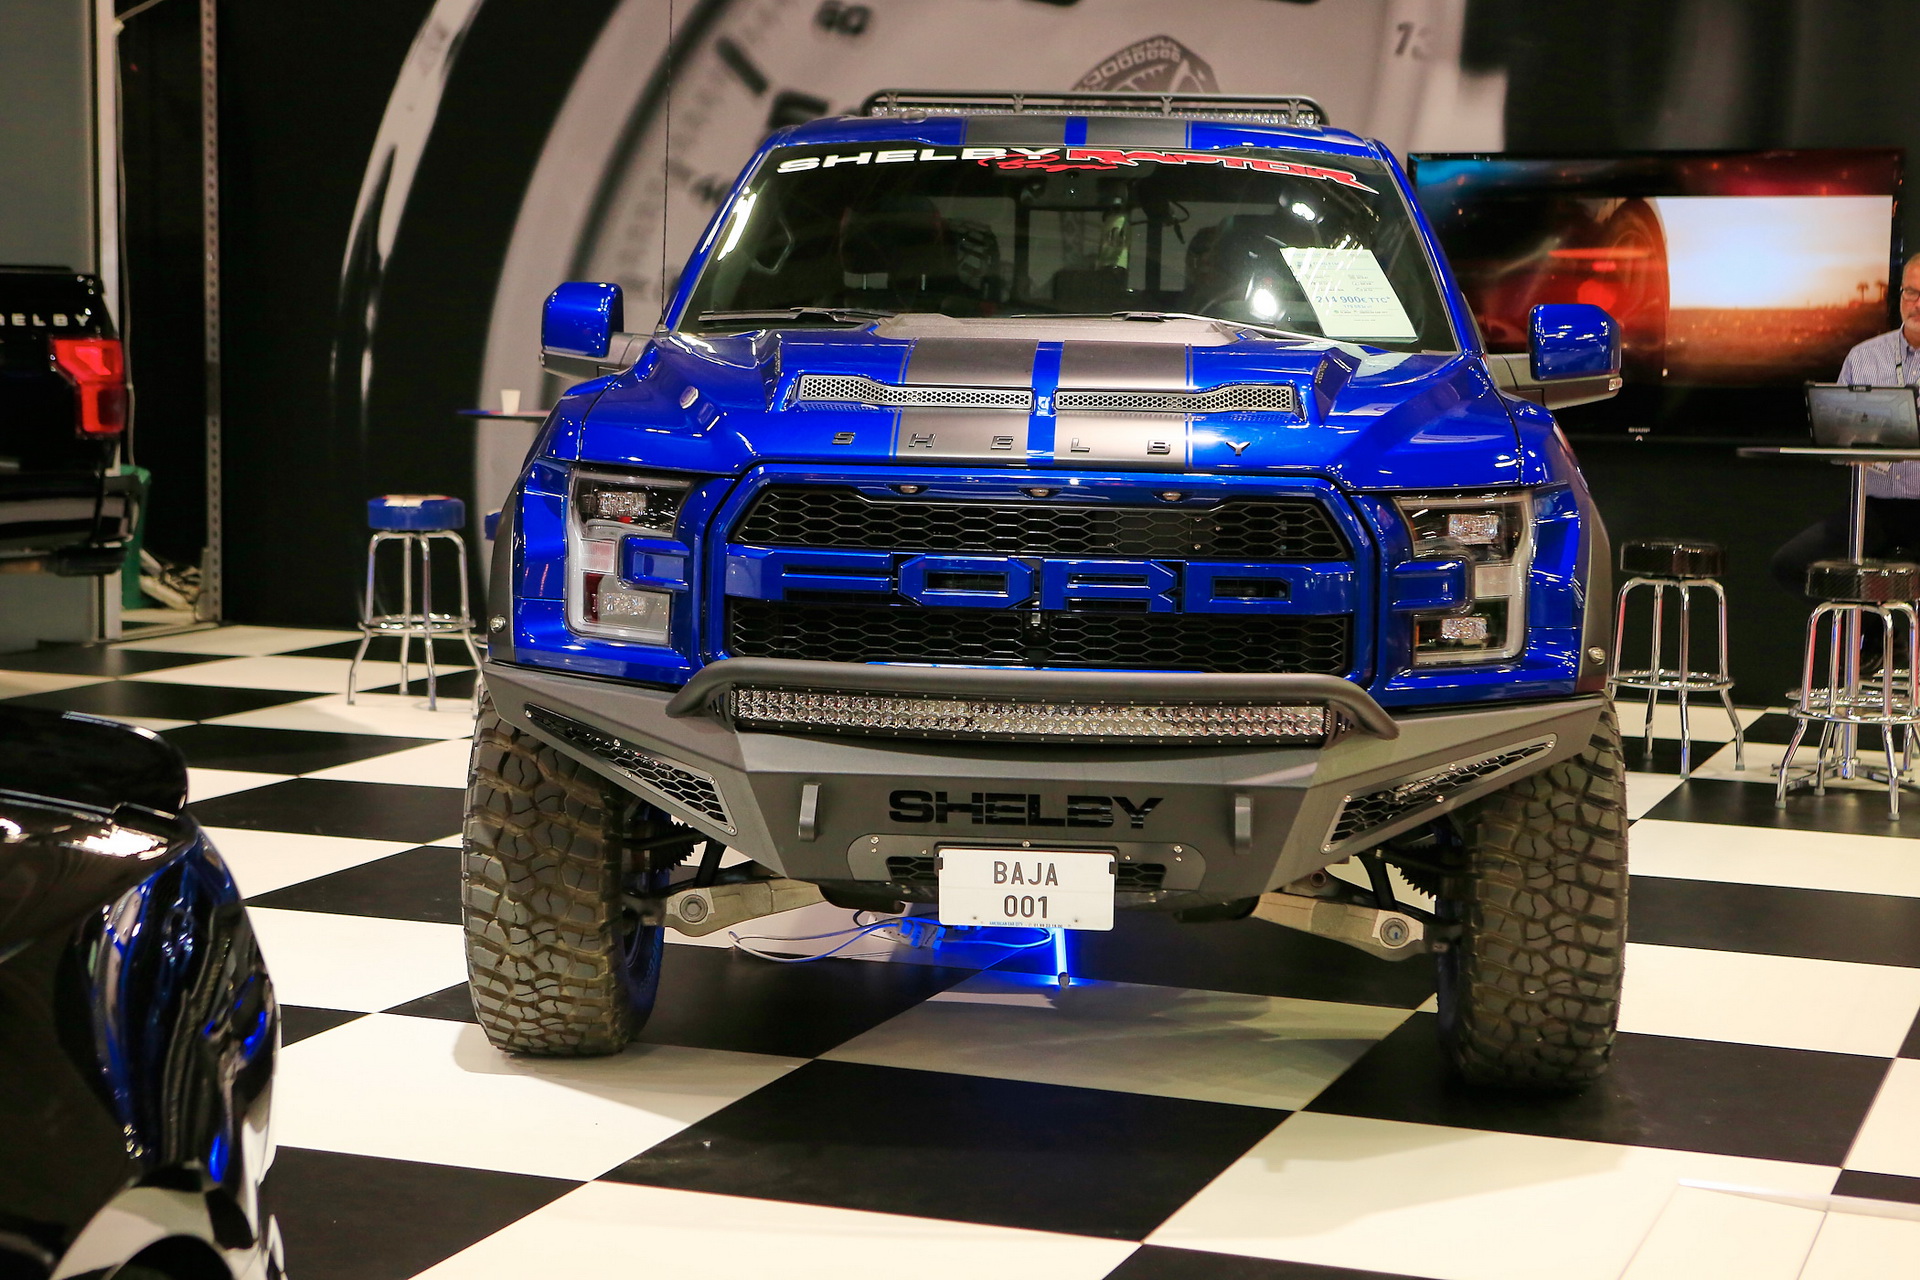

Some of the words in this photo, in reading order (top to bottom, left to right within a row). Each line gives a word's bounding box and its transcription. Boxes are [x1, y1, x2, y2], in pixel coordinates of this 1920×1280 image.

[777, 148, 1060, 173] SHELBY
[1066, 147, 1380, 195] RAPTOR
[831, 431, 1251, 456] SHELBY
[725, 543, 1354, 614] FORD
[888, 790, 1164, 829] SHELBY
[993, 861, 1059, 886] BAJA
[1003, 895, 1048, 918] 001
